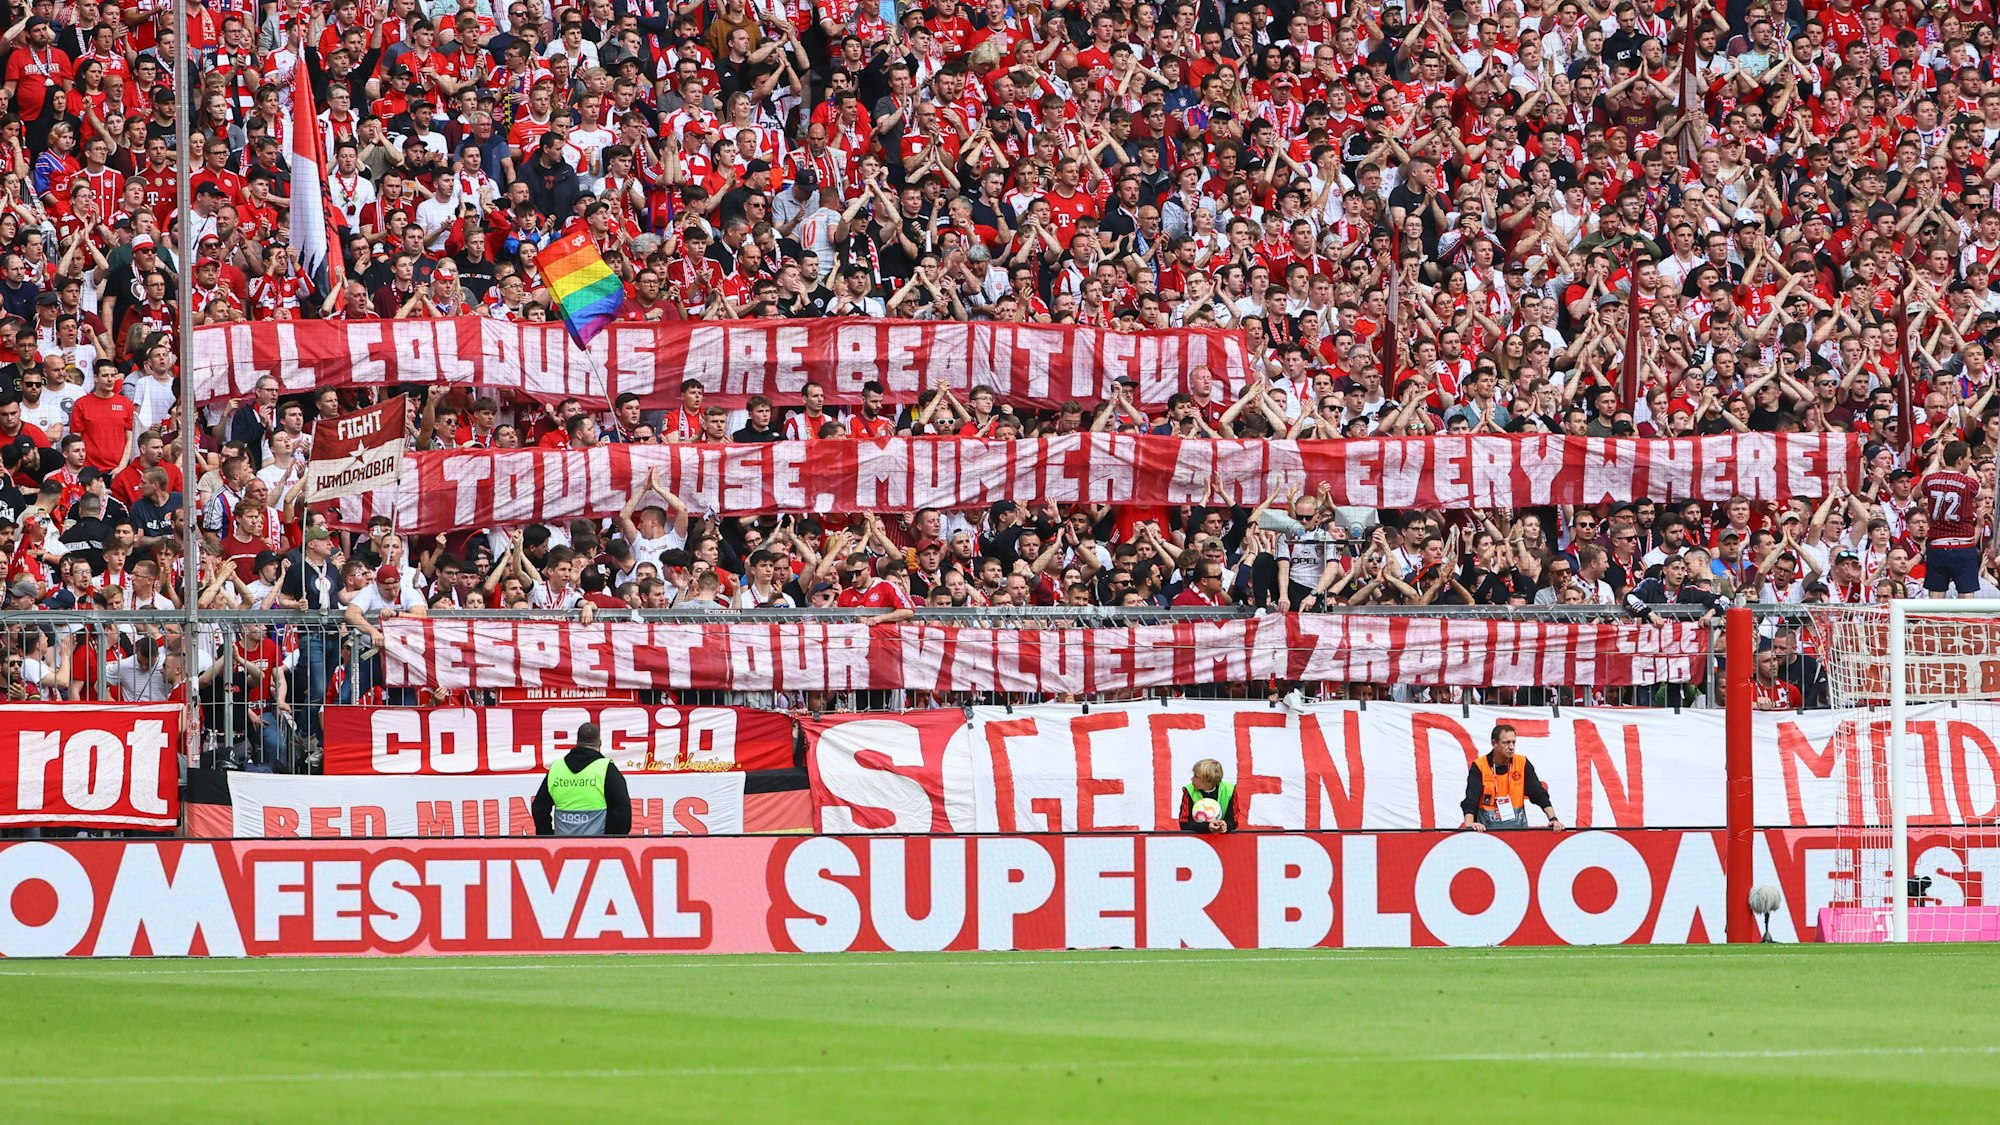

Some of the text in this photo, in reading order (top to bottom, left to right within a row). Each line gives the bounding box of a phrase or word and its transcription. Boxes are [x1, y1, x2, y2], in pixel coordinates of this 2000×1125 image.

[760, 121, 782, 130] OPE
[194, 317, 1247, 404] ALL COLOURS ARE BEAUTIFUL!
[337, 409, 382, 441] FIGHT
[857, 433, 1136, 508] MUNICH
[1168, 439, 1307, 504] AND
[1930, 490, 1961, 521] 72
[1292, 557, 1319, 565] OPEL
[383, 619, 704, 690] RESPECT
[728, 622, 871, 691] OUR
[901, 623, 1178, 694] VALUES
[17, 719, 169, 815] rot
[553, 776, 597, 788] Steward
[561, 813, 589, 824] 1990
[254, 858, 700, 942] FESTIVAL
